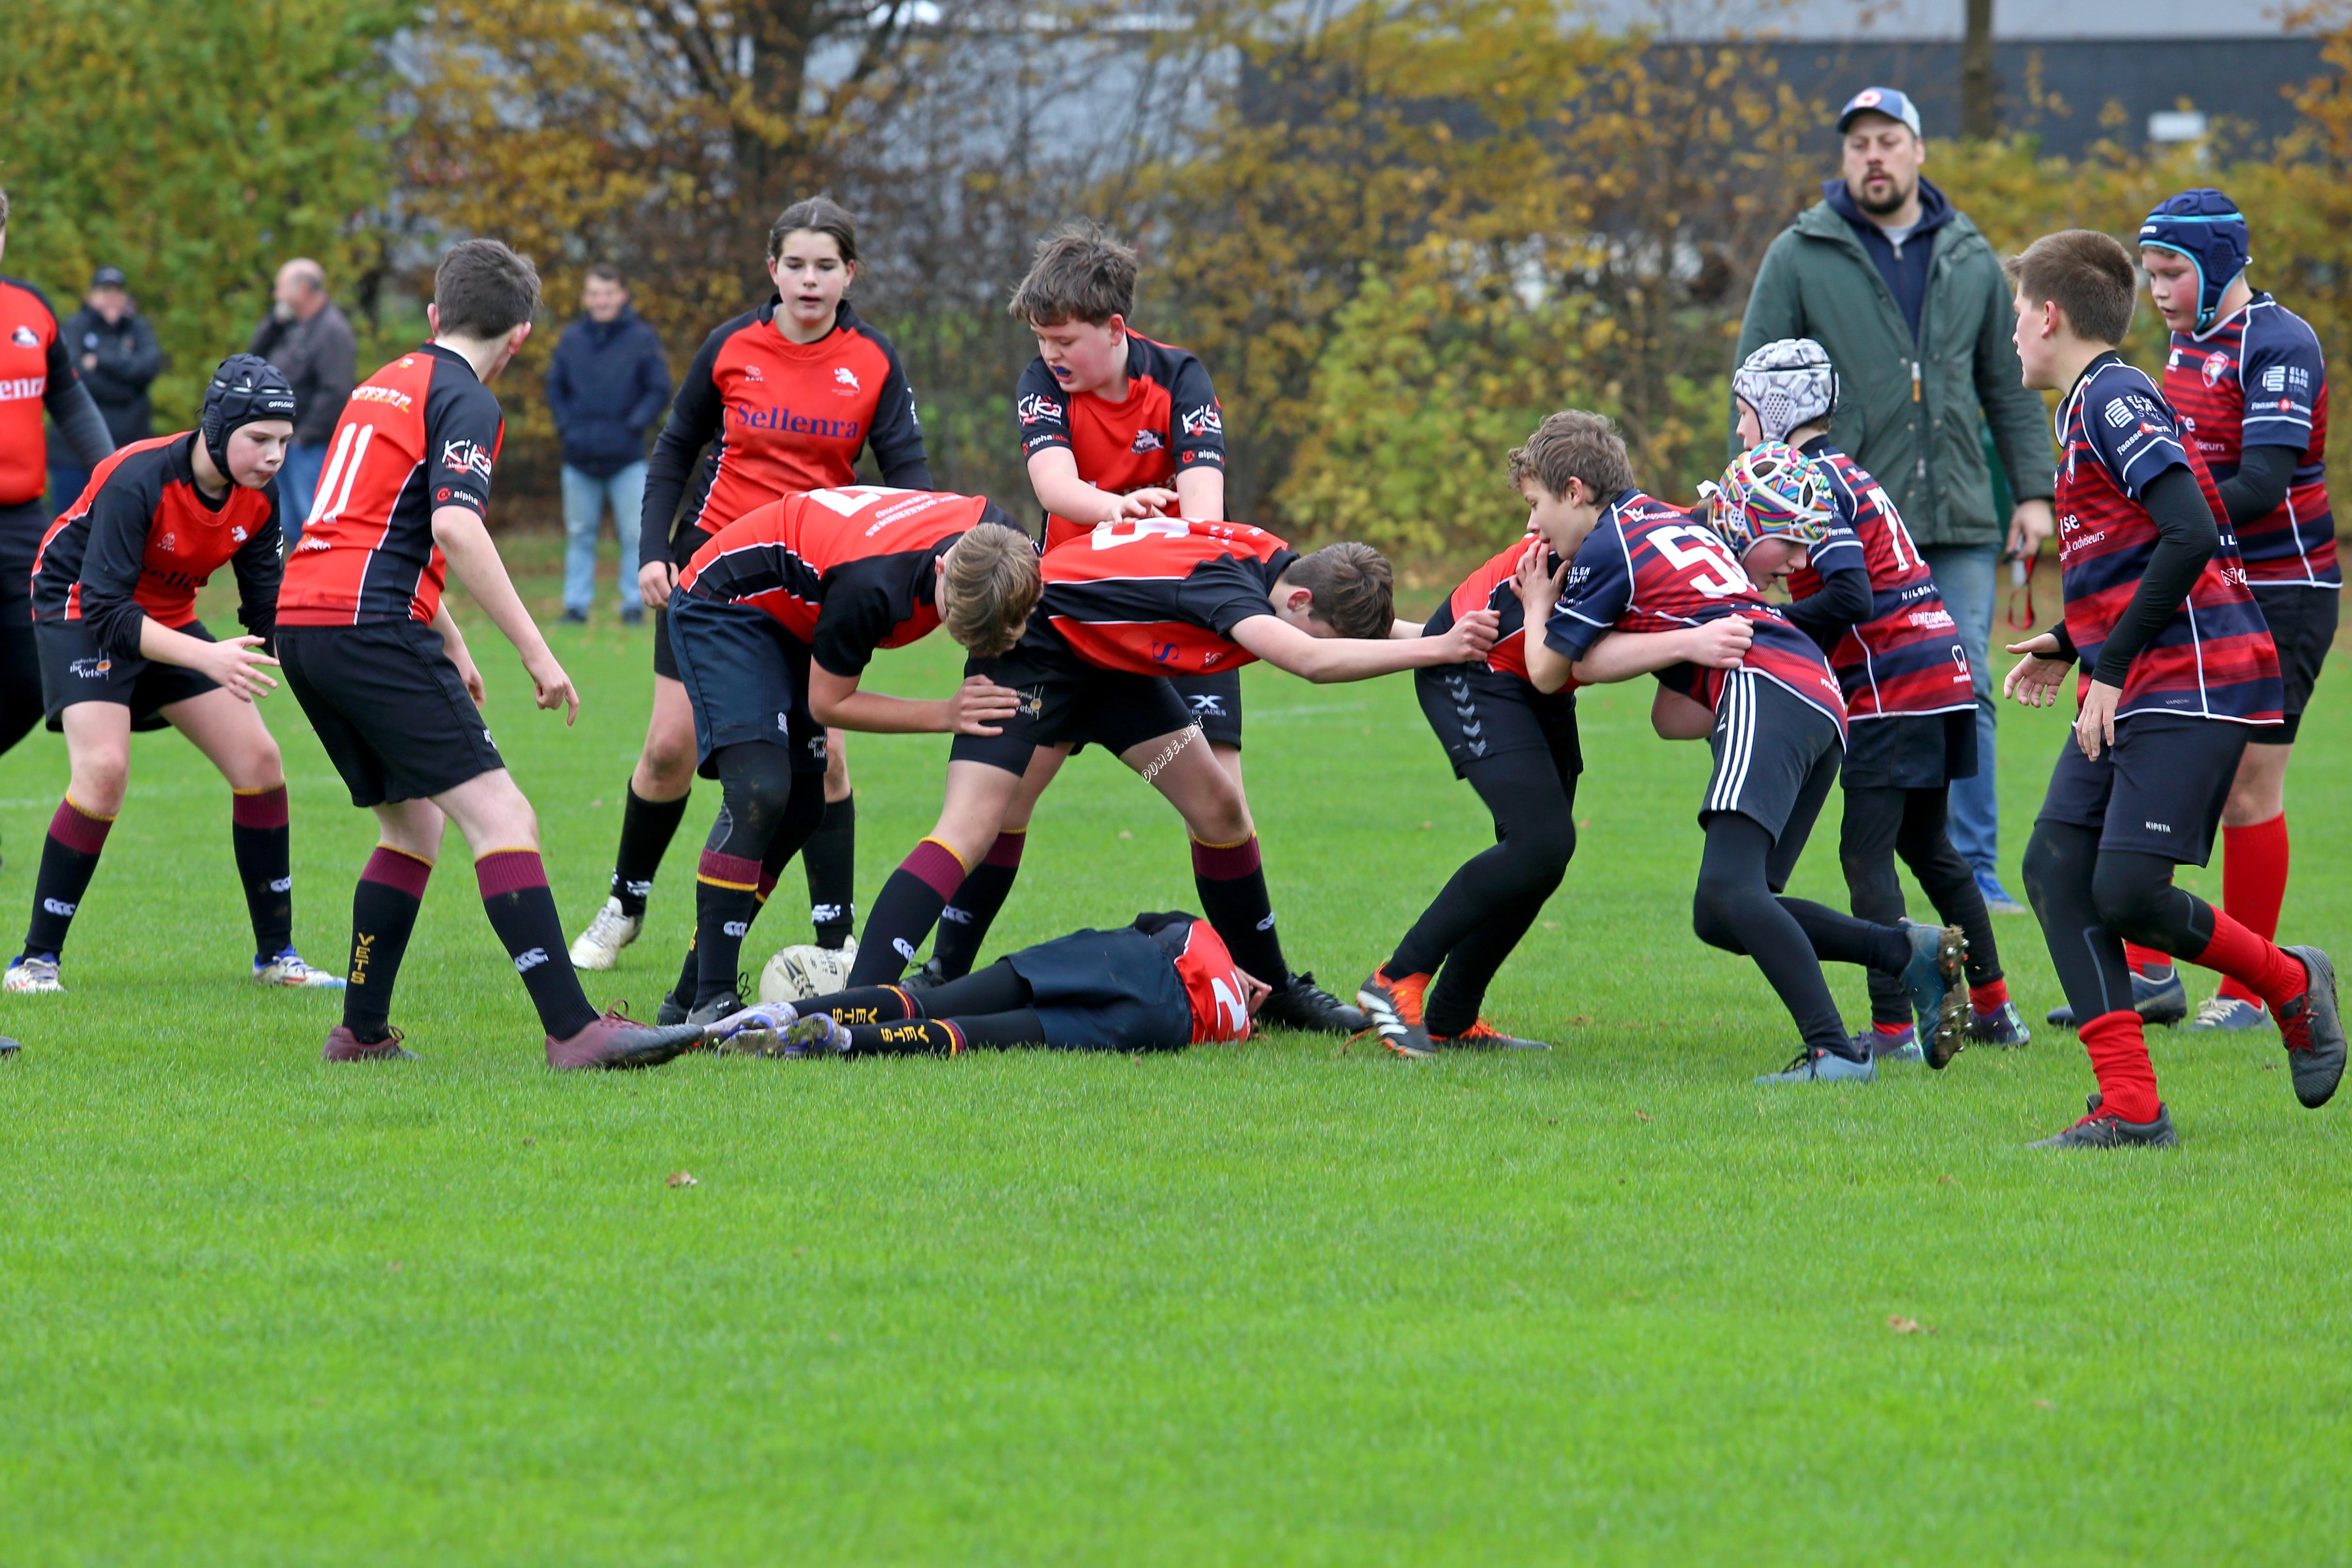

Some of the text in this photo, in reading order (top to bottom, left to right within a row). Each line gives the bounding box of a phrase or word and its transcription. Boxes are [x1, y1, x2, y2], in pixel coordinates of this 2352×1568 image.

[735, 402, 860, 439] Sellenra
[2117, 430, 2144, 456] Faasse
[2072, 530, 2105, 551] adviseurs
[2146, 821, 2171, 833] KIPSTA
[350, 932, 375, 985] VETS
[832, 1007, 878, 1025] VETS
[880, 1024, 930, 1044] VETS
